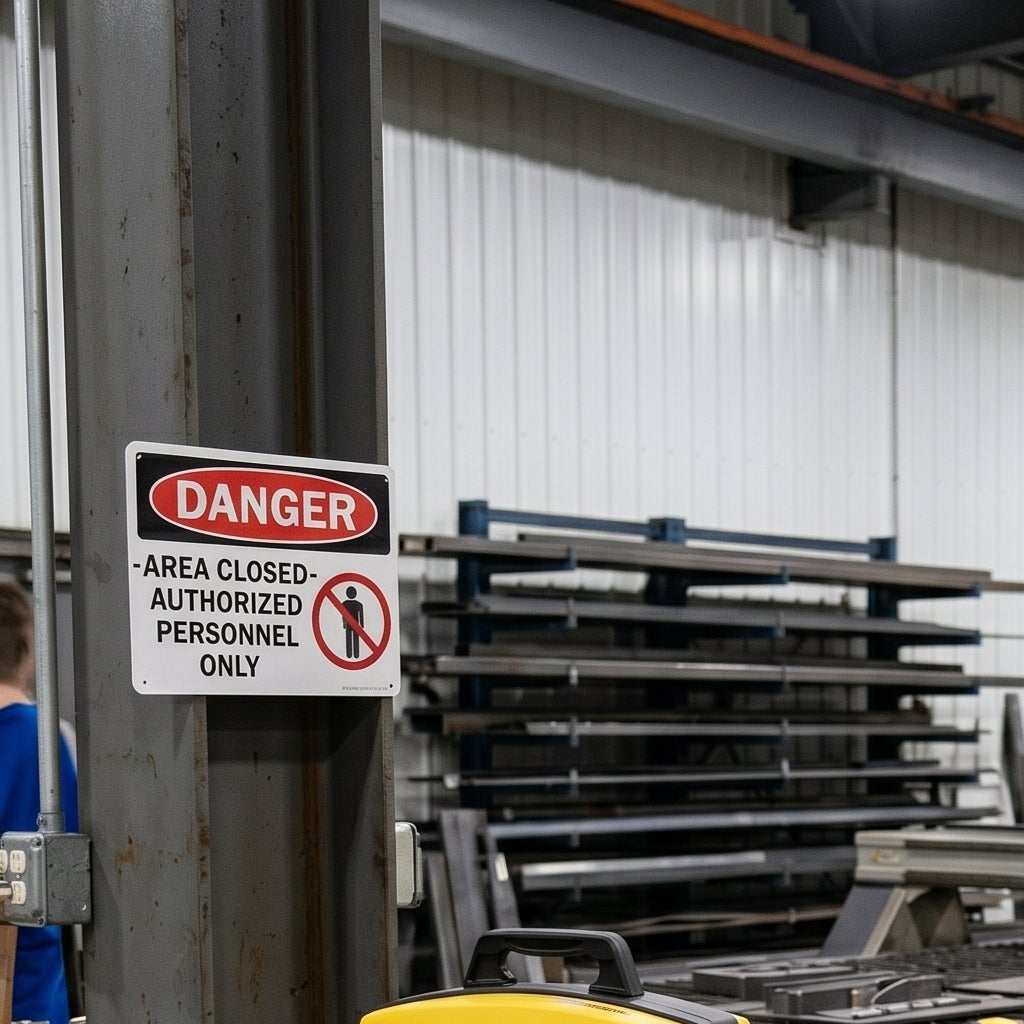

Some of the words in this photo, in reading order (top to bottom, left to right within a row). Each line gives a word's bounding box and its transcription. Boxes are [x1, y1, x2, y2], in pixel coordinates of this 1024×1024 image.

[176, 479, 357, 532] DANGER
[150, 587, 303, 616] AUTHORIZED
[156, 620, 299, 647] PERSONNEL
[199, 654, 260, 678] ONLY
